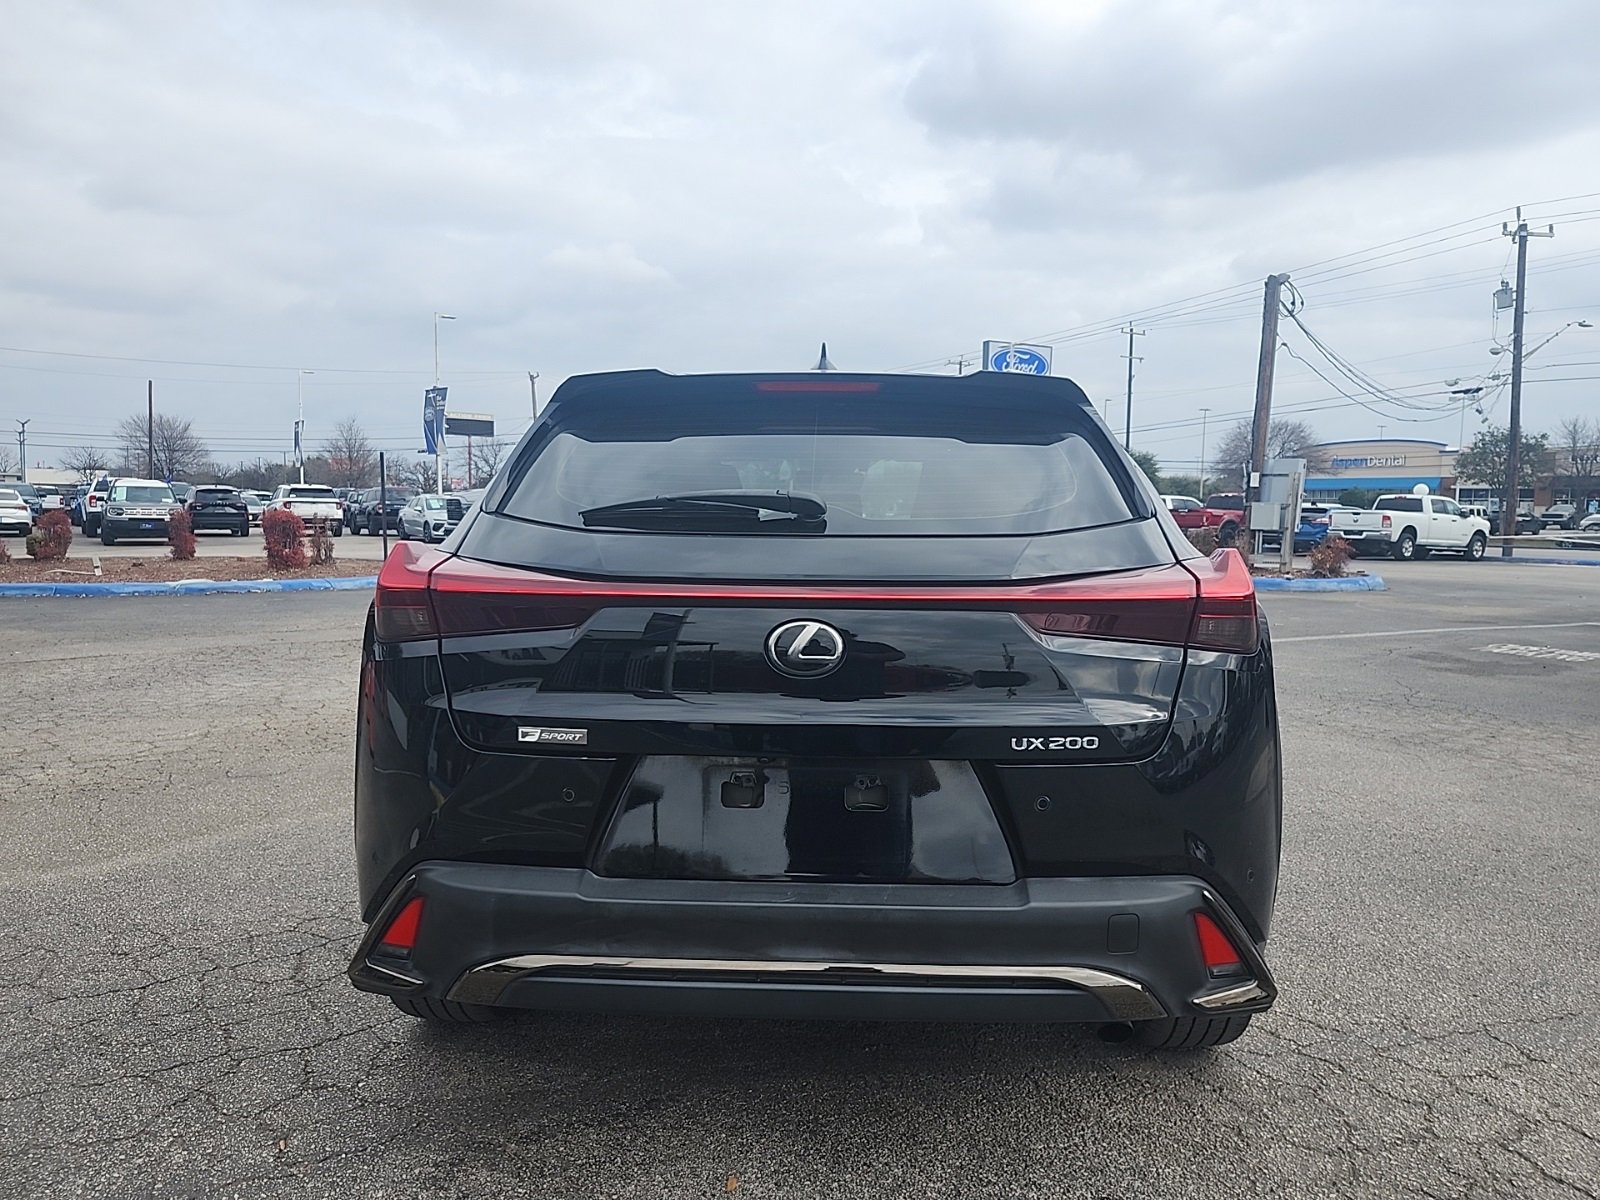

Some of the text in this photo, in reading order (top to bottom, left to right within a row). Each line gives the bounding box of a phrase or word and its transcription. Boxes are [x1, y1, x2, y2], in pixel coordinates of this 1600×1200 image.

[1002, 351, 1039, 375] Ford
[540, 732, 584, 742] SPORT
[1011, 736, 1099, 751] UX 200
